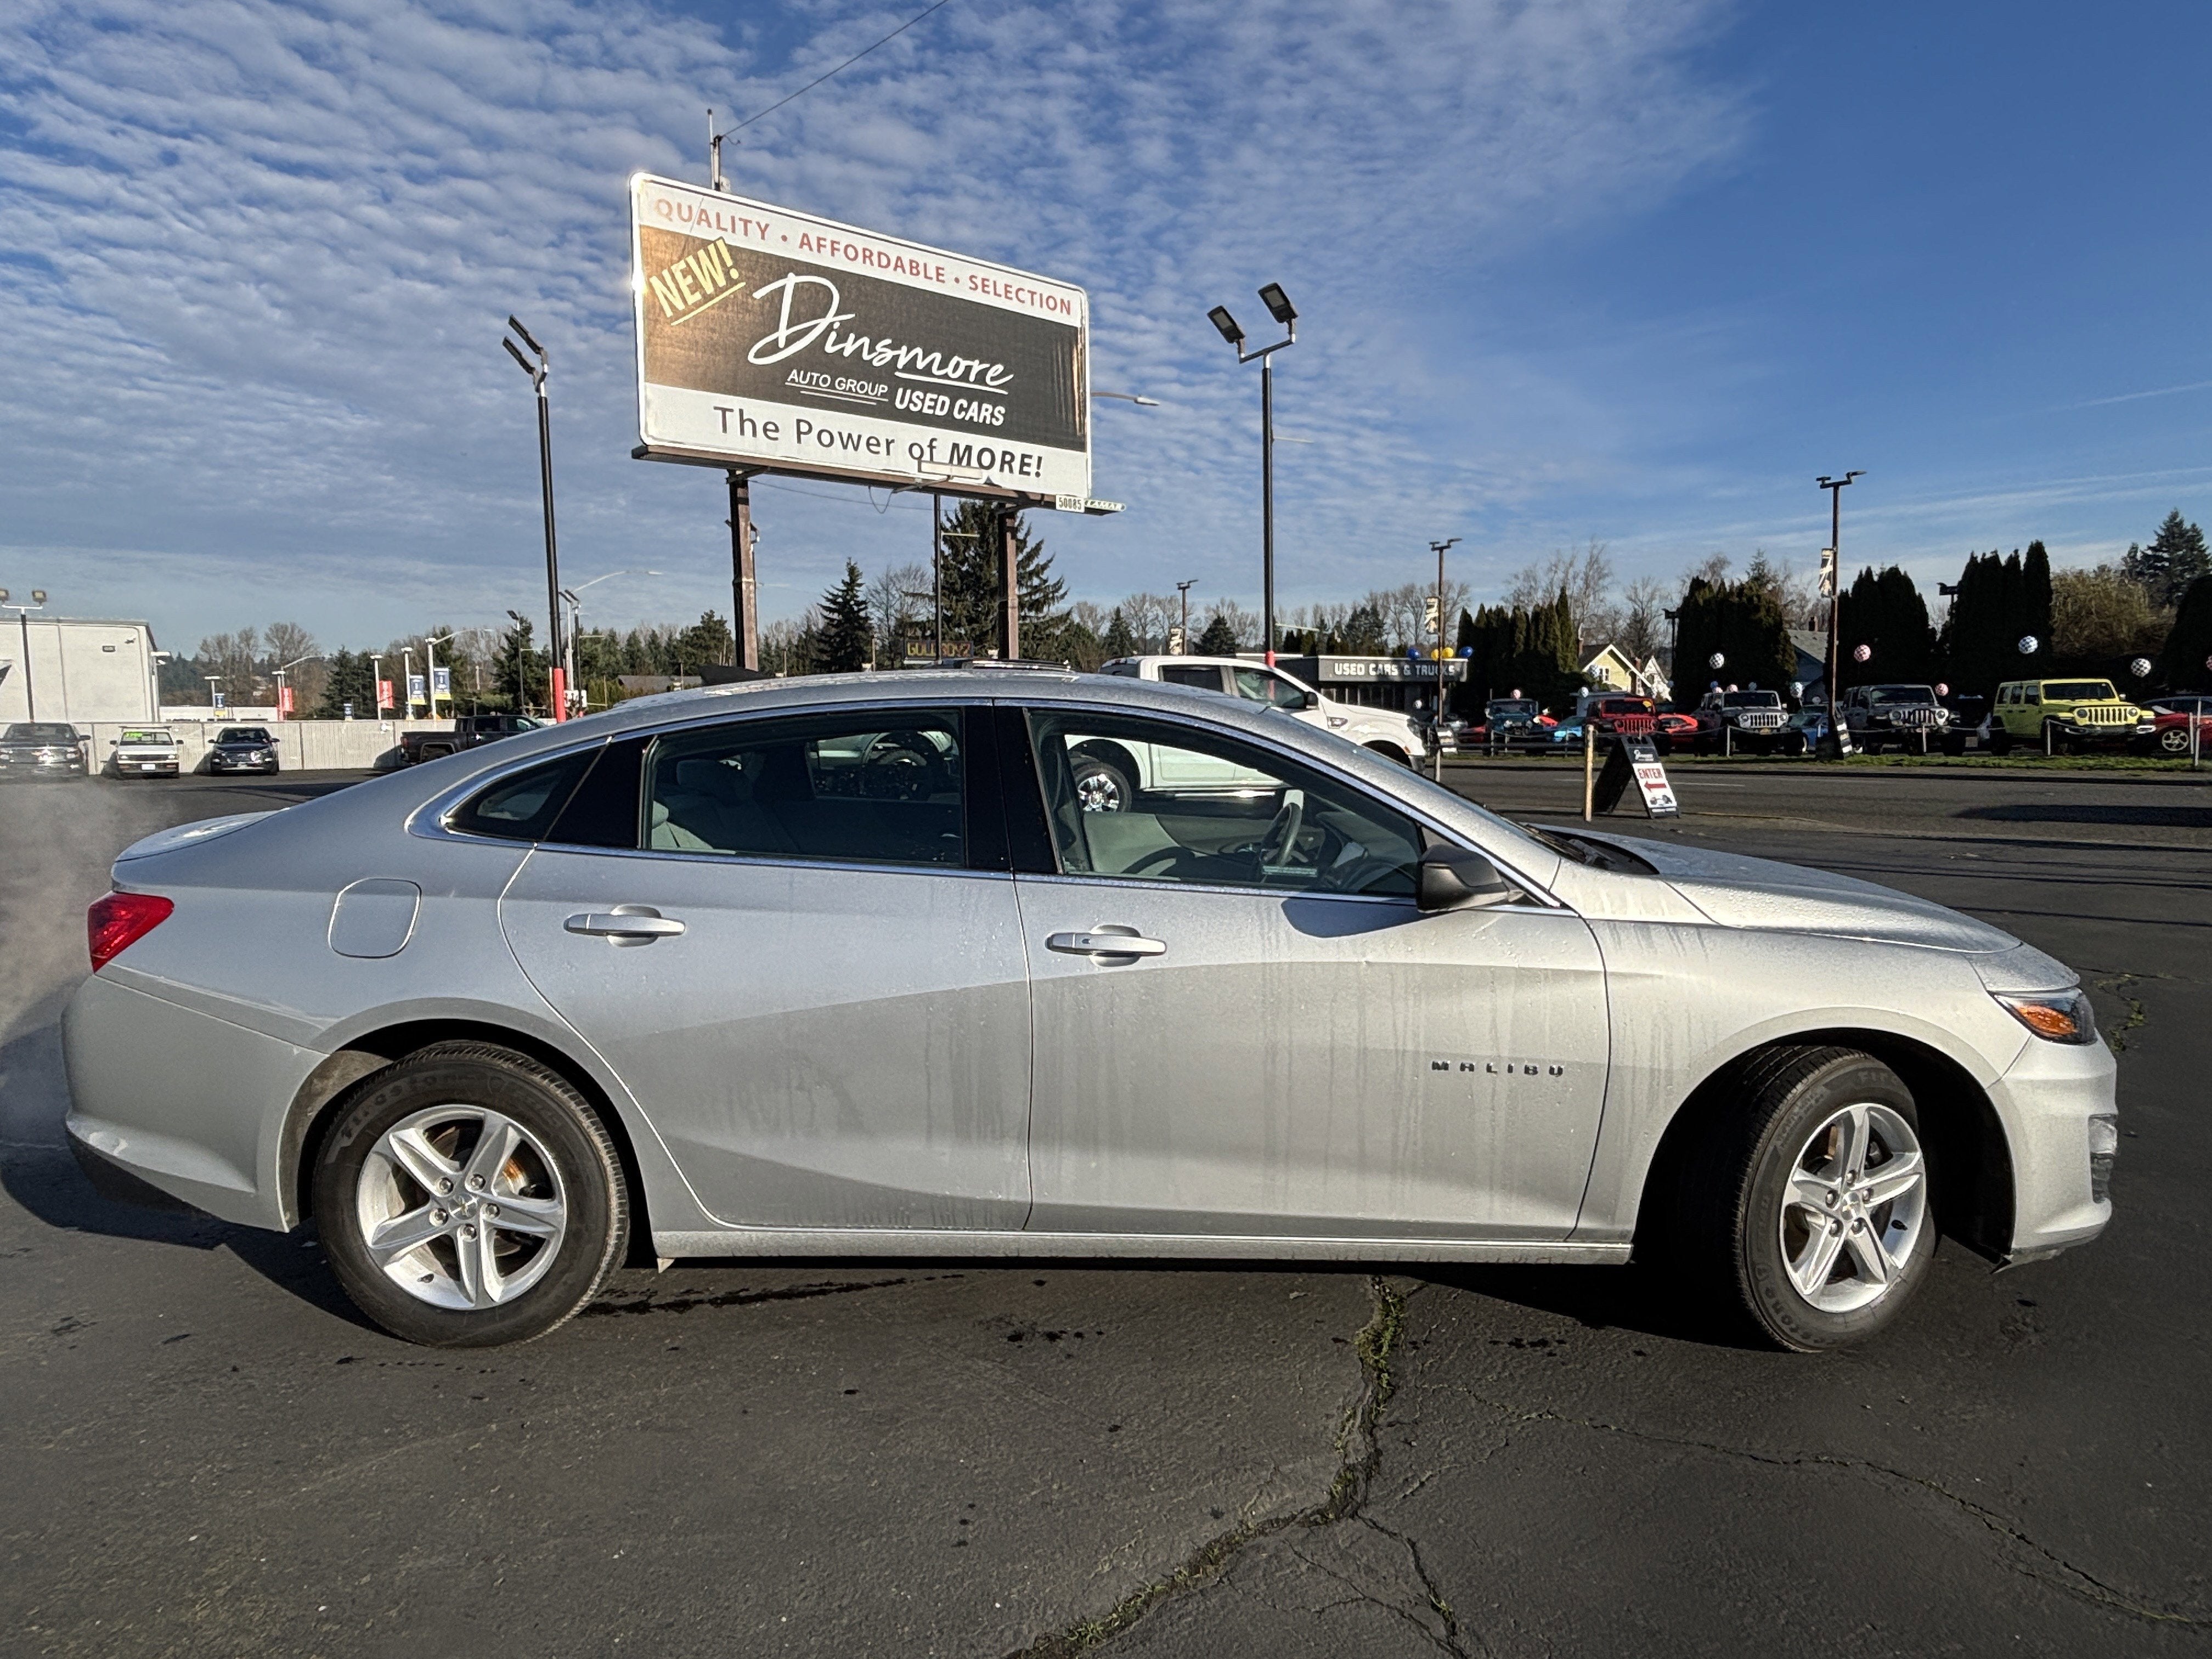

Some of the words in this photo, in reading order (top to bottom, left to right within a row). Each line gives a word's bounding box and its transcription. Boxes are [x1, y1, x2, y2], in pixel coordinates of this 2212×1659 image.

[653, 199, 770, 240] QUALITY
[798, 233, 945, 284] AFFORDABLE
[969, 274, 1071, 315] SELECTION
[650, 238, 739, 318] NEW!
[748, 272, 1014, 386] Dinsmore
[787, 369, 831, 387] AUTO
[835, 377, 888, 397] GROUP
[895, 387, 950, 416] USED
[953, 399, 1006, 426] CARS
[713, 406, 780, 441] The
[796, 419, 895, 456] Power
[909, 438, 938, 462] of
[949, 442, 1042, 478] MORE!
[1334, 663, 1365, 675] USED
[1369, 663, 1398, 676] CARS
[1403, 664, 1412, 676] &
[1638, 768, 1663, 778] ENTER
[1431, 1060, 1564, 1077] MALIBU
